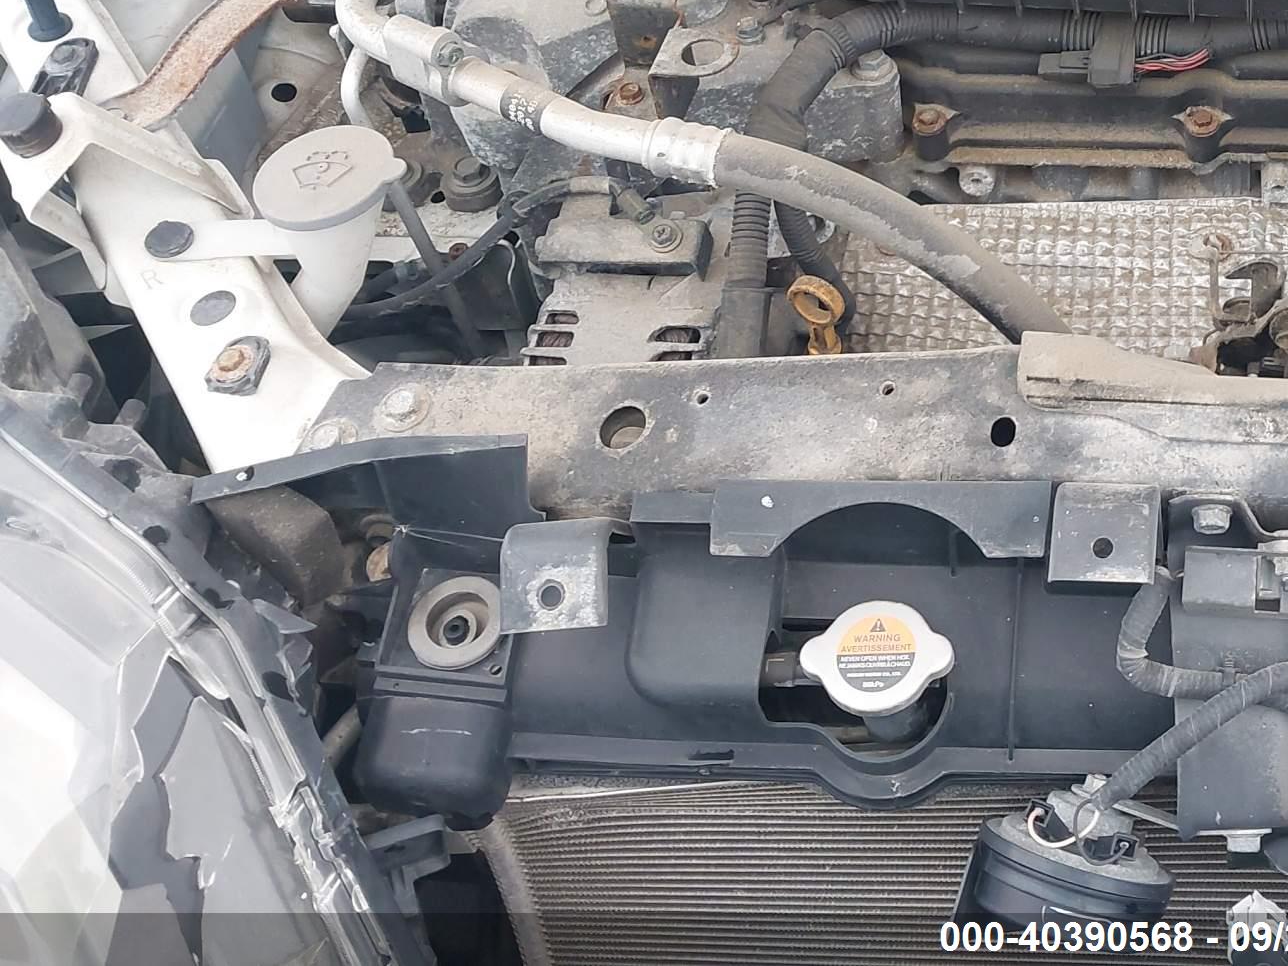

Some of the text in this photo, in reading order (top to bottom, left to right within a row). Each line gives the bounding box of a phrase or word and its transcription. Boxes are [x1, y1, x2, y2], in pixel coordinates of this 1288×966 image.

[140, 268, 164, 290] R
[854, 634, 901, 642] WARNING
[841, 644, 912, 652] AVERTISSEMENT
